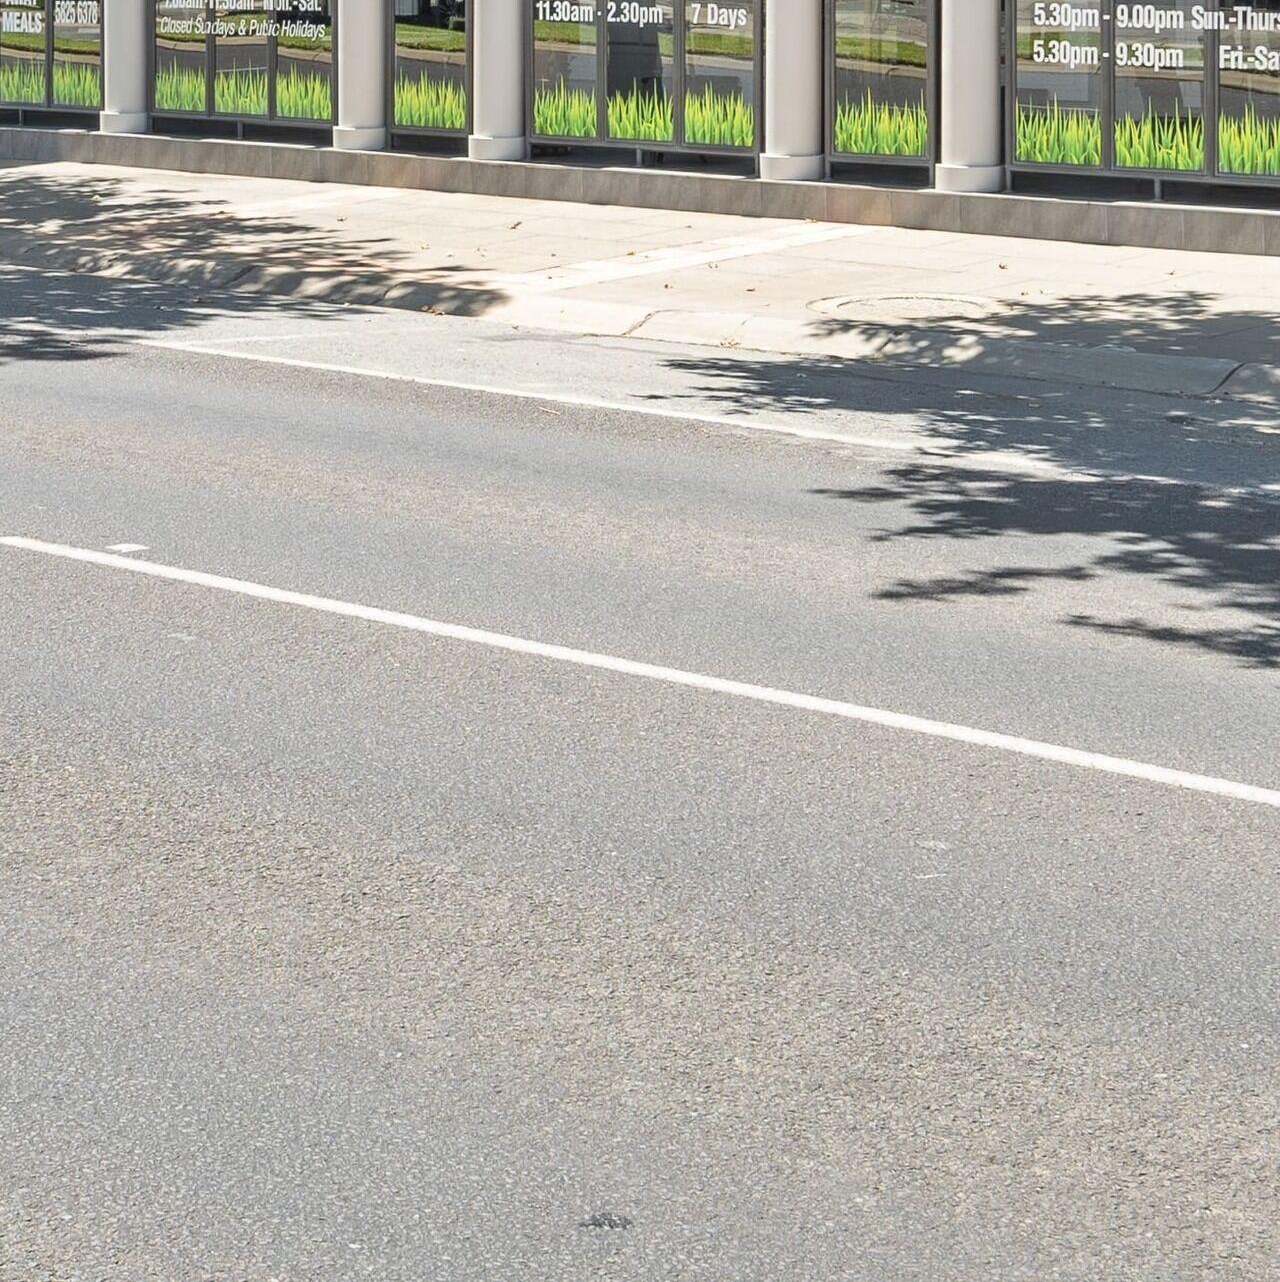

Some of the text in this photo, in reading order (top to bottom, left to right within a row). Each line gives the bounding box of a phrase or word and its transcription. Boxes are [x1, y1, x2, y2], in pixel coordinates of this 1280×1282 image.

[2, 12, 42, 33] MEALS
[54, 0, 98, 24] 5825 6378
[535, 0, 594, 23] 11.30am
[607, 1, 663, 28] 2.30pm
[691, 3, 702, 24] 7
[707, 3, 747, 29] Days
[1033, 2, 1099, 31] 5.30pm
[1116, 4, 1184, 33] 9.00pm
[160, 16, 193, 34] Closed
[195, 17, 235, 38] Sundays
[238, 19, 247, 36] &
[281, 19, 326, 42] Holidays
[1032, 40, 1098, 68] 5.30pm
[1115, 42, 1184, 71] 9.30pm
